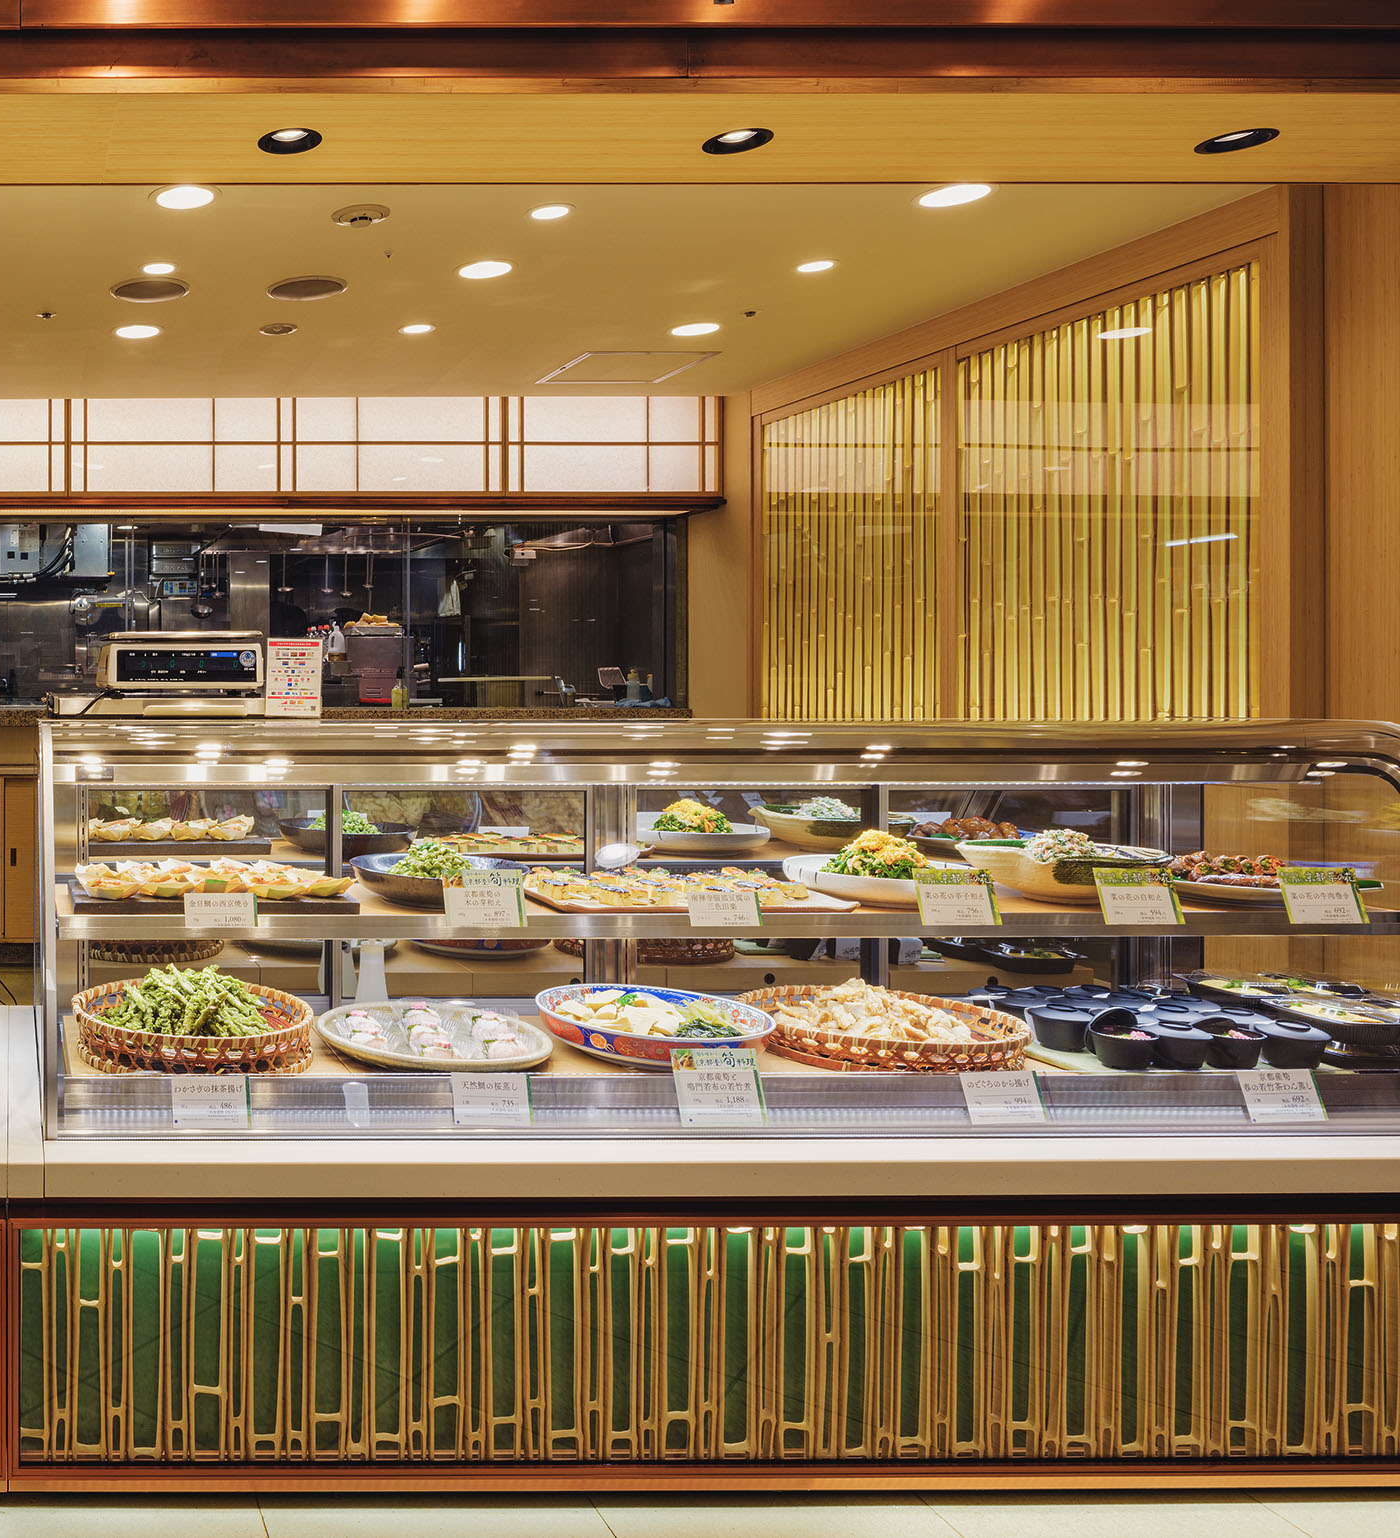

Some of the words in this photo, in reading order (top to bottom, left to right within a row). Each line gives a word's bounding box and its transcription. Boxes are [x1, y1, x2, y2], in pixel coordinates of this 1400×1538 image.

[462, 1081, 518, 1091] 天然鯛の桜蒸し
[966, 1079, 1030, 1088] のどぐろのから揚げ
[174, 1084, 243, 1093] わかさぎの抹茶揚げ
